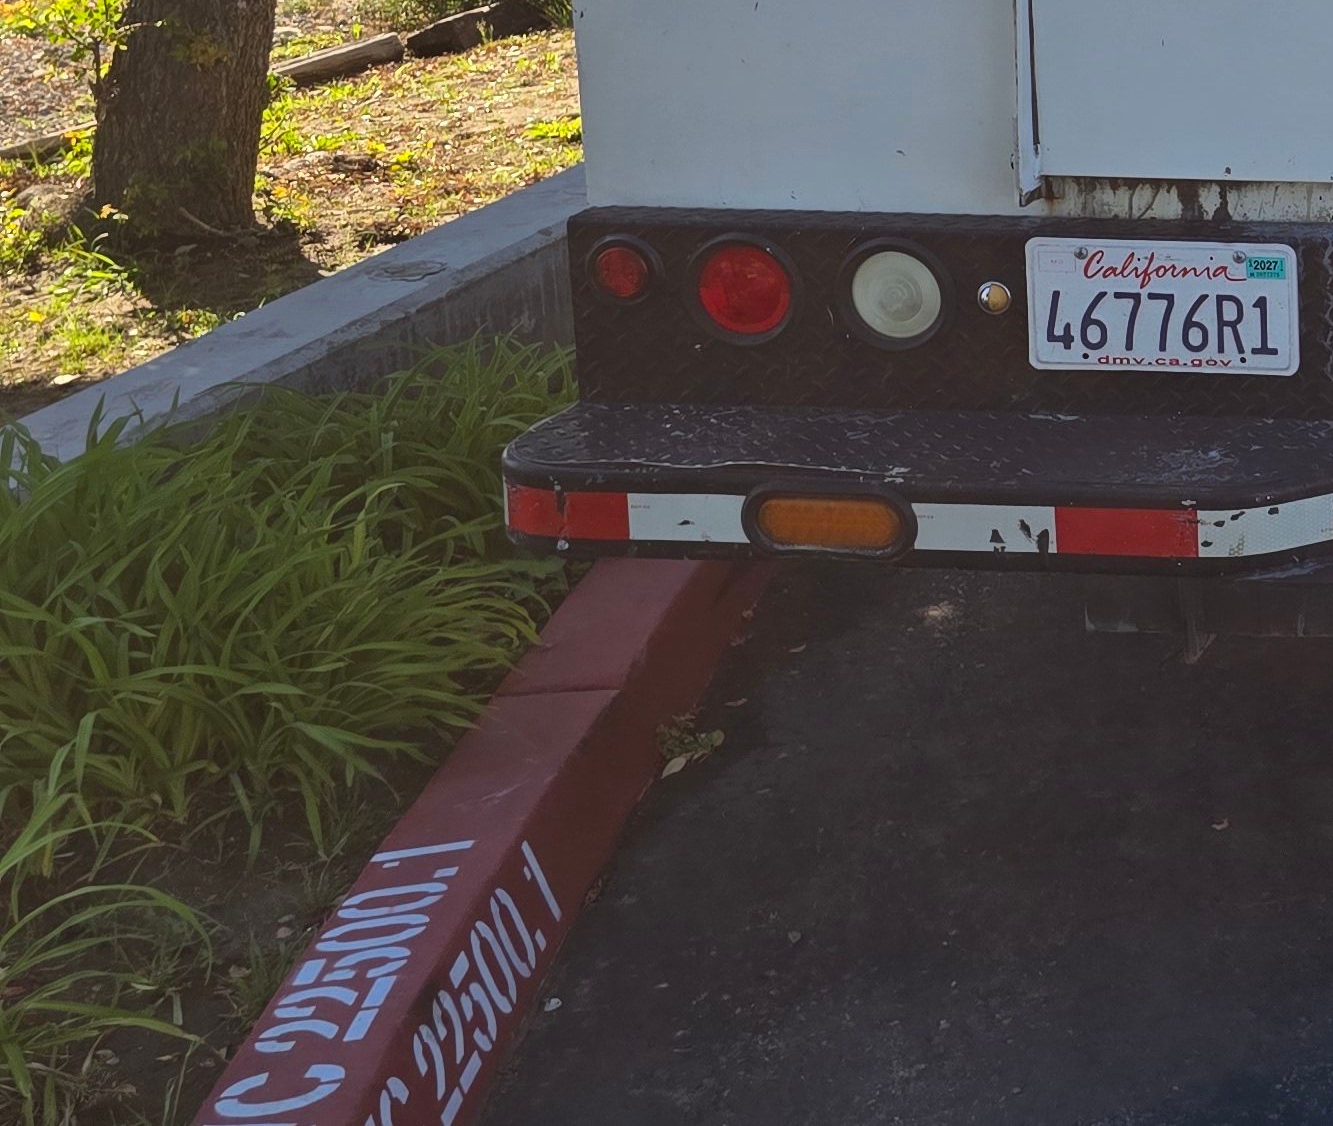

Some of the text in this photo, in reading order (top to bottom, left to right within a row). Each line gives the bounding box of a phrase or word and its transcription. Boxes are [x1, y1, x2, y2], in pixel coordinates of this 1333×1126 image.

[1083, 249, 1247, 289] California
[1253, 259, 1279, 271] 2027
[1046, 289, 1279, 356] 46776R1
[1097, 354, 1232, 368] dmv.ca.gov
[254, 840, 475, 1054] 22500.1
[413, 840, 562, 1126] 22500.1
